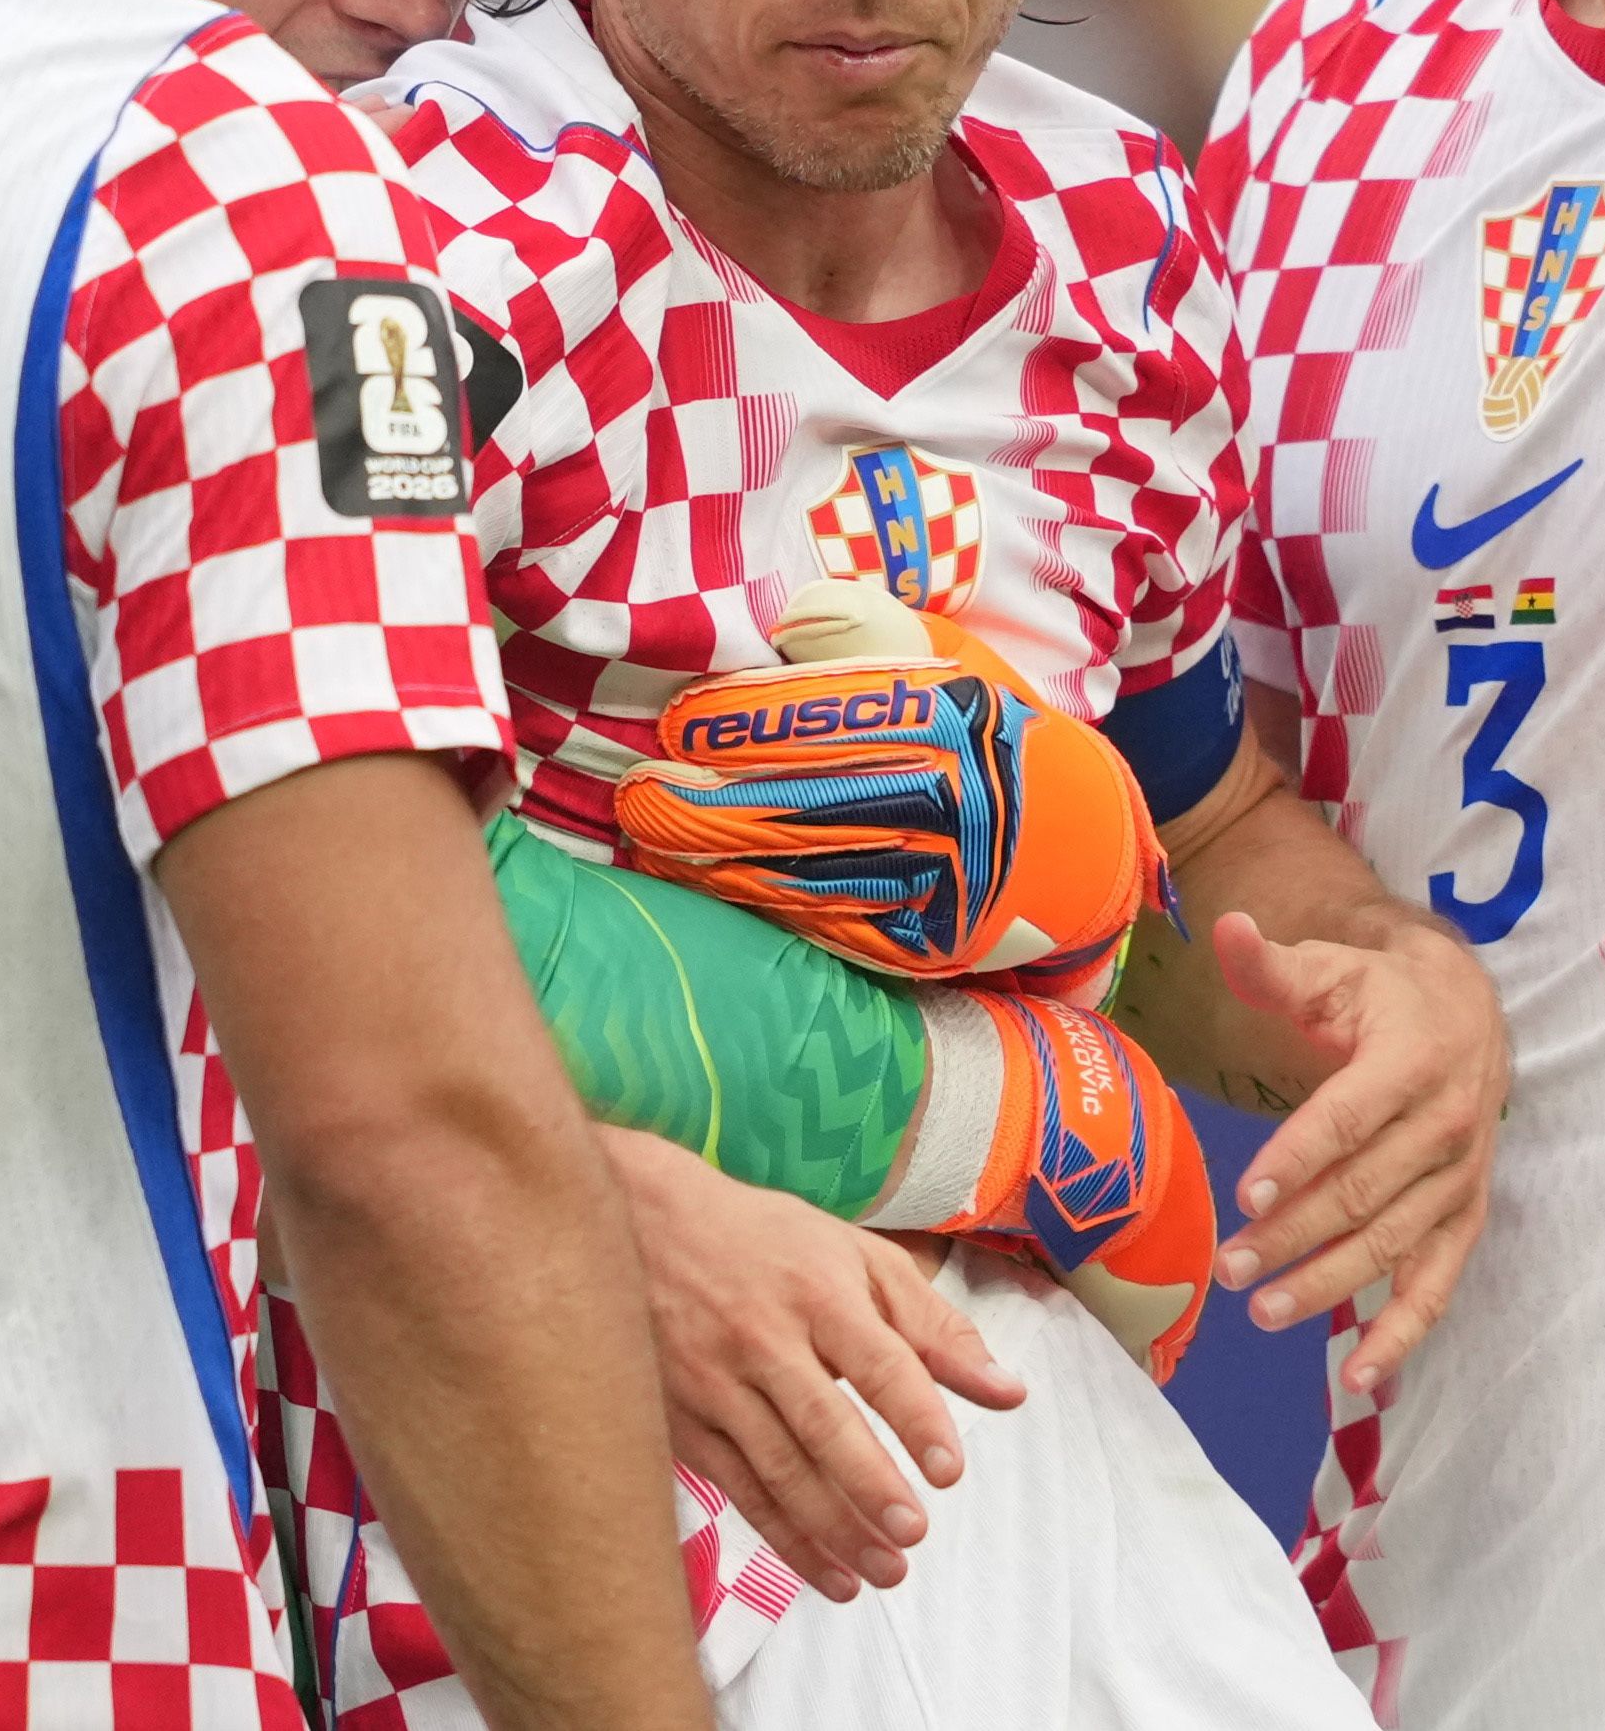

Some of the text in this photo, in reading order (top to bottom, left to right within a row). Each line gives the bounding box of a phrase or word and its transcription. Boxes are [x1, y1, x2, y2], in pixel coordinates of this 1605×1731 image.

[1522, 202, 1583, 331] HNS
[367, 474, 458, 500] 2026
[873, 466, 922, 606] HNS
[682, 679, 932, 752] reusch
[1429, 639, 1548, 944] 3
